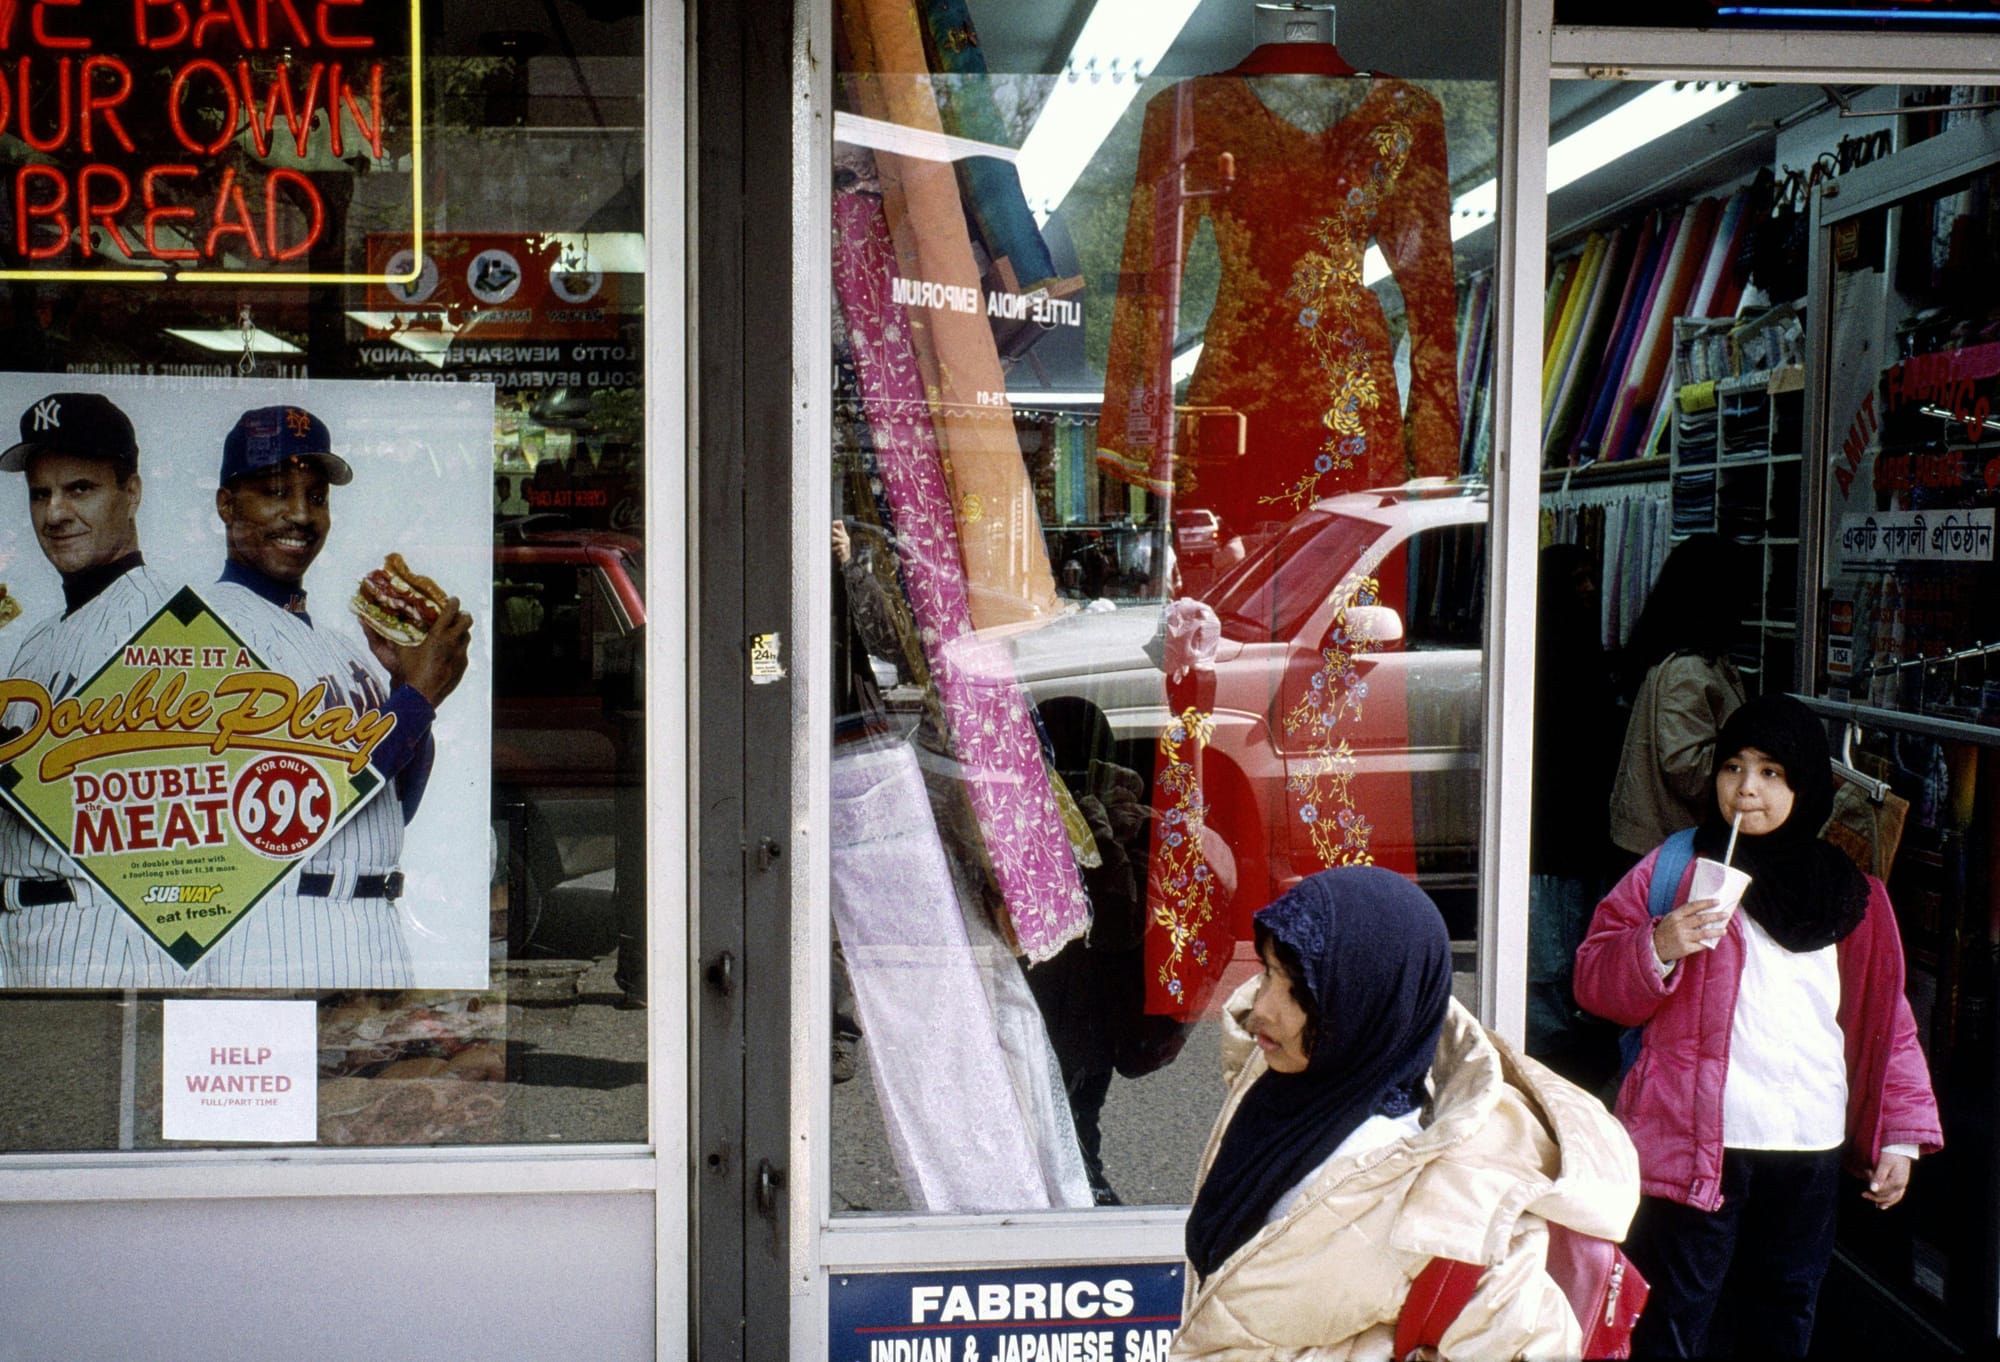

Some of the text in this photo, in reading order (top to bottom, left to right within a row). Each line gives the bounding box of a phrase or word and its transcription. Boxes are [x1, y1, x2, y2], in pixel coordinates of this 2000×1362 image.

[0, 0, 92, 49] E
[169, 58, 383, 158] OWN
[16, 164, 324, 261] BREAD
[1835, 390, 1878, 501] AMIT
[1888, 352, 1992, 445] FABRICS
[125, 648, 251, 668] MAKE IT A
[0, 668, 214, 765] Double
[210, 671, 396, 772] Play
[255, 759, 309, 775] FOR ONLY
[74, 765, 228, 804] DOUBLE
[238, 776, 325, 837] 69¢
[74, 799, 228, 855] MEAT
[255, 837, 309, 852] 6-inch sub
[142, 859, 169, 868] double
[141, 883, 224, 905] SUBWAY
[156, 904, 232, 924] eat fresh.
[210, 1047, 272, 1065] HELP
[186, 1075, 291, 1093] WANTED
[201, 1098, 279, 1107] FULL/PART TIME
[912, 1279, 1135, 1324] FABRICS
[870, 1329, 1179, 1362] INDIAN & JAPANESE SAR
